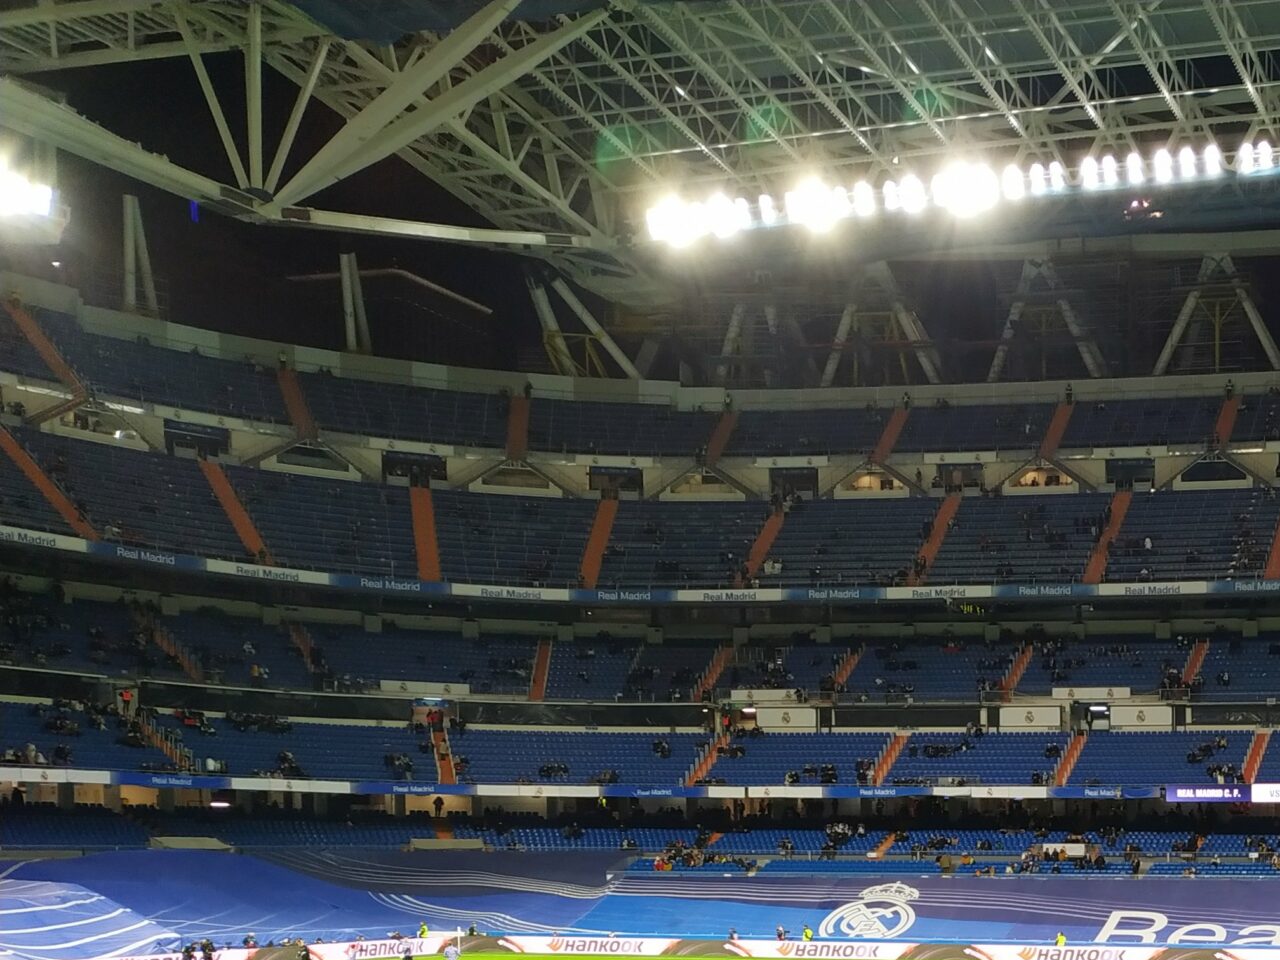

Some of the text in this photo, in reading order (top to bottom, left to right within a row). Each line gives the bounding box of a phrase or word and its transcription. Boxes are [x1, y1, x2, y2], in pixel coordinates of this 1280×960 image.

[18, 532, 56, 547] Madrid
[117, 547, 175, 565] Real Madrid
[236, 565, 299, 582] Real Madrid
[361, 578, 420, 591] Real Madrid
[1235, 582, 1256, 591] Real
[481, 588, 542, 599] Real Madrid
[808, 589, 860, 598] Real Madrid
[912, 589, 932, 598] Real
[1019, 586, 1071, 595] Real Madrid
[1125, 585, 1181, 595] Real Madrid
[598, 591, 651, 600] Real Madrid
[703, 592, 757, 601] Real Madrid
[170, 777, 192, 786] Madrid
[410, 785, 435, 793] Madrid
[1177, 788, 1195, 797] REAL
[1196, 788, 1223, 797] MADRID
[1269, 789, 1280, 798] VS
